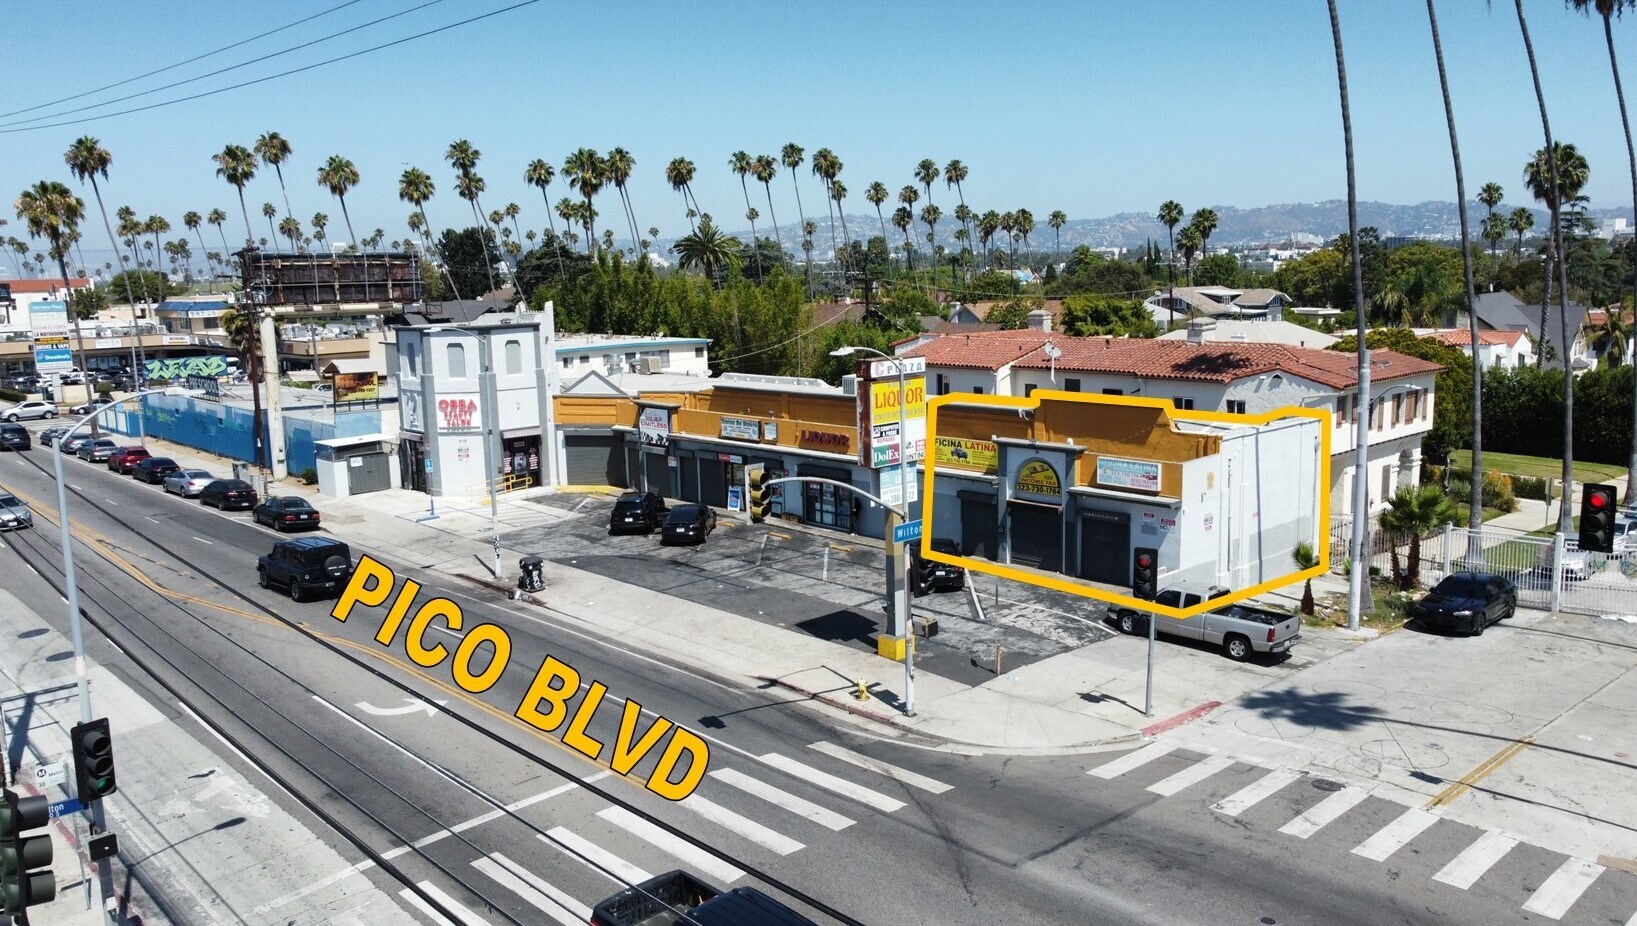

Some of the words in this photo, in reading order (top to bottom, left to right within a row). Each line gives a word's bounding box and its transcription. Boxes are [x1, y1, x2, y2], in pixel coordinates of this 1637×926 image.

[875, 386, 923, 409] LIQUOR
[800, 429, 850, 447] LIQUOR
[935, 438, 962, 449] FICINA
[964, 441, 997, 452] LATINA
[874, 449, 900, 463] DolEx
[1021, 477, 1043, 485] INCOME
[1017, 483, 1061, 495] 323-730-1764
[49, 803, 64, 812] lton
